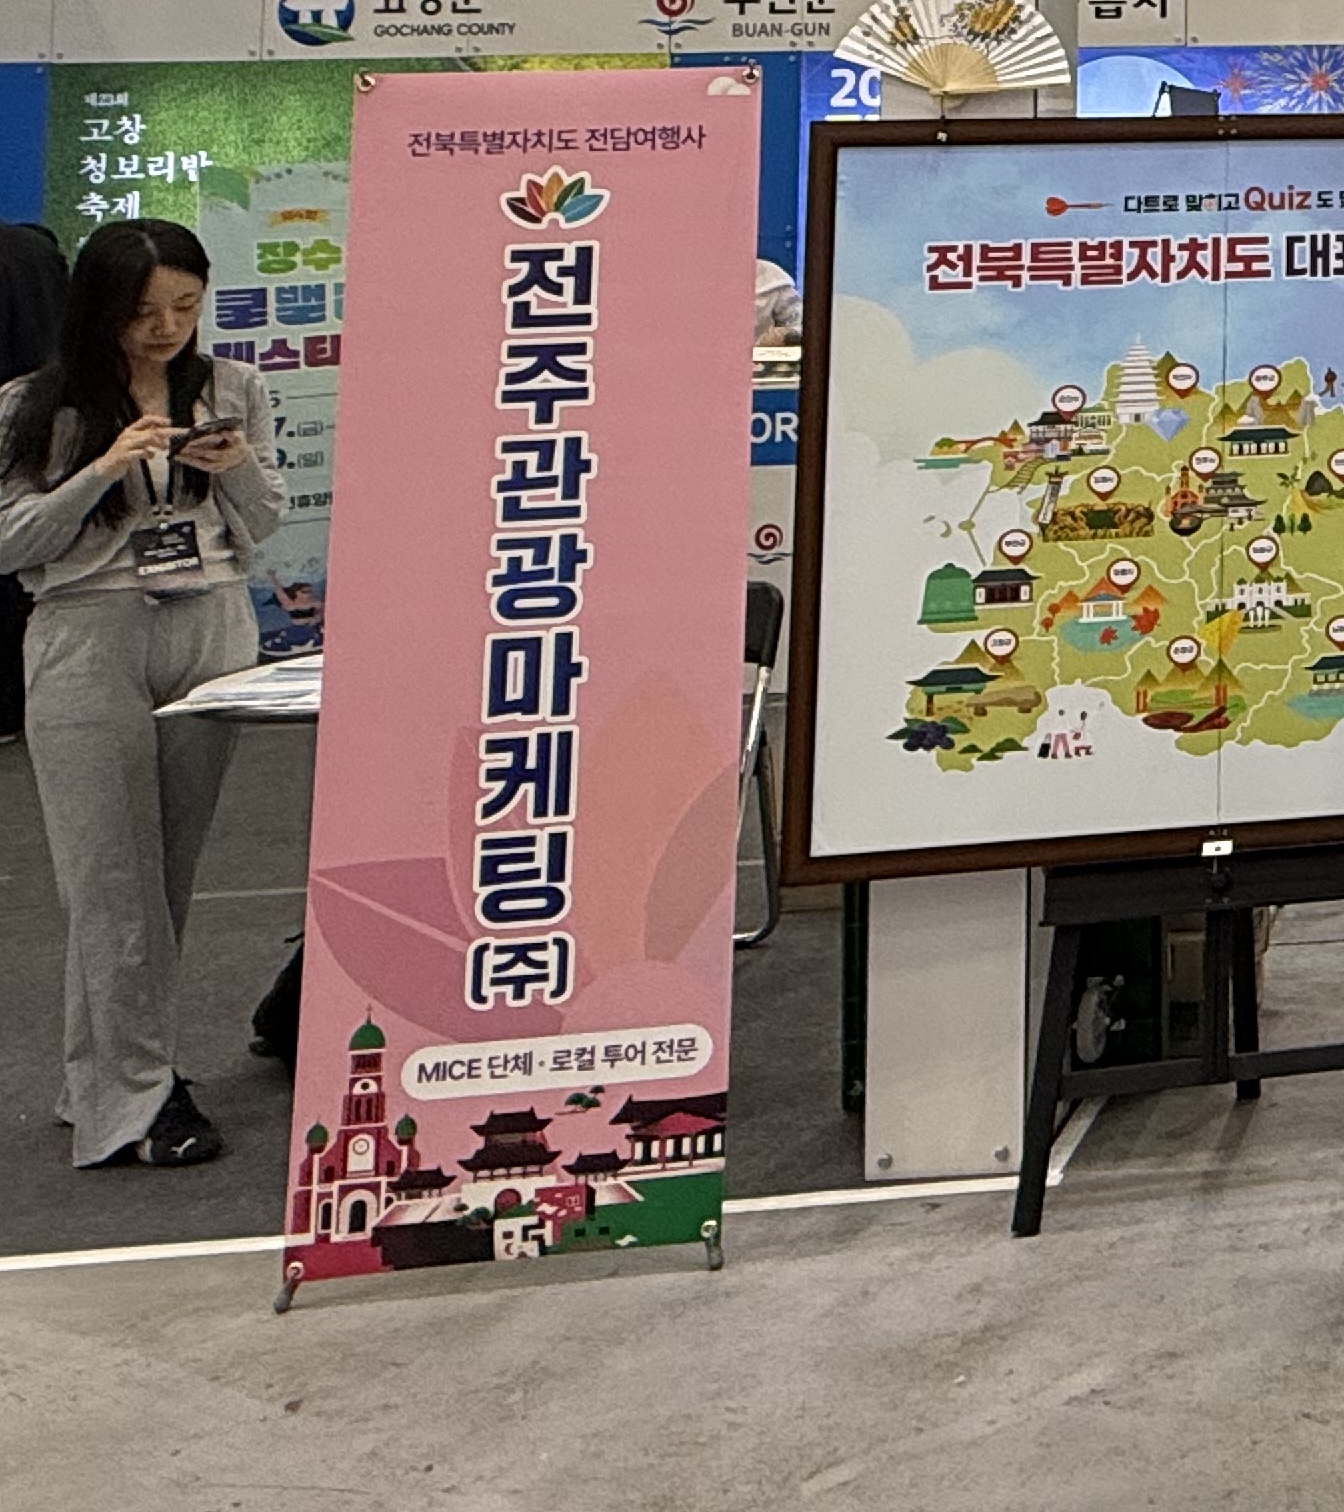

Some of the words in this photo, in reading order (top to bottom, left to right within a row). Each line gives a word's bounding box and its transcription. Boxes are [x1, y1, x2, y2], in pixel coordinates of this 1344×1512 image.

[373, 23, 453, 37] GOCHANG
[456, 22, 516, 36] COUNTY
[732, 22, 830, 37] BUAN-GUN
[79, 114, 147, 144] 고창
[408, 129, 580, 157] 전북특별자치도
[585, 124, 706, 153] 전담여행사
[76, 191, 140, 222] 축제
[1124, 194, 1180, 214] 다트로
[1244, 185, 1312, 212] Quiz
[257, 239, 342, 274] 장수
[925, 235, 1272, 292] 전북특별자치도
[417, 1059, 481, 1083] MICE
[487, 1052, 533, 1080] 단체
[550, 1047, 596, 1075] 로컬
[601, 1043, 646, 1069] 투어
[652, 1038, 698, 1065] 전문
